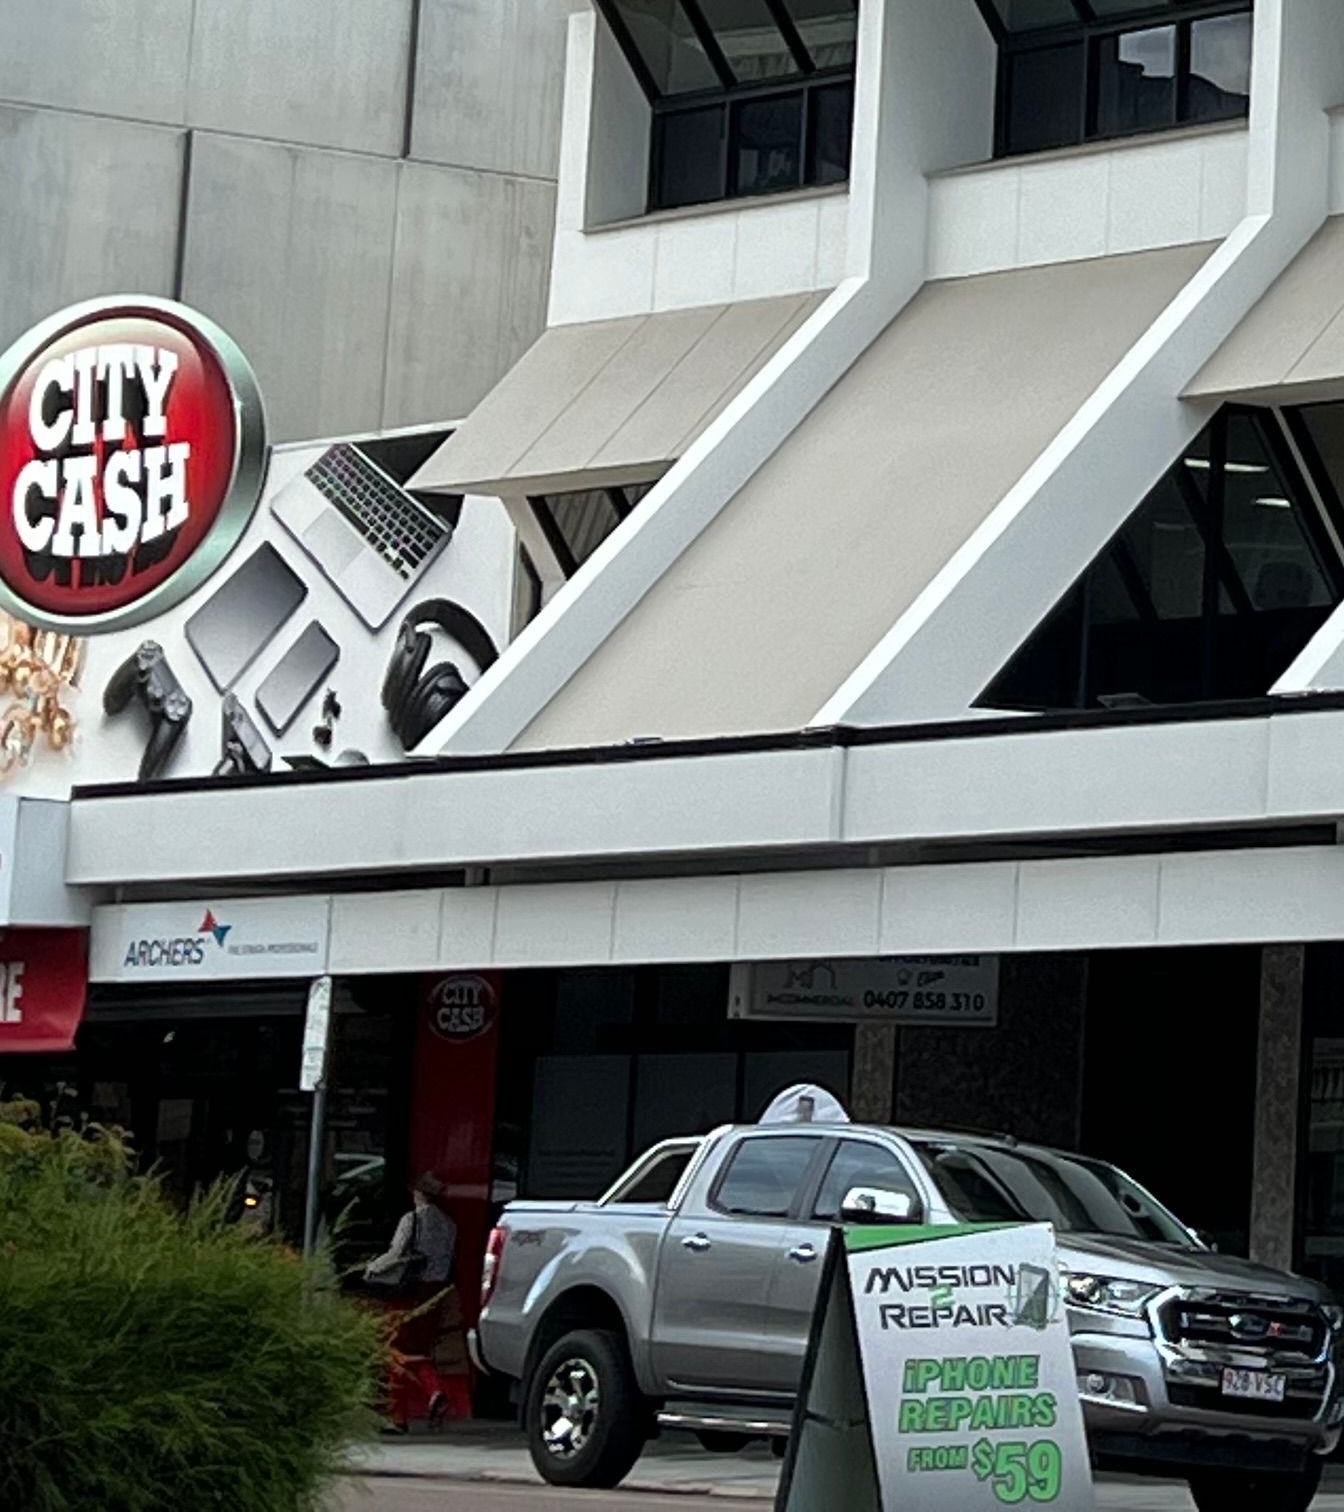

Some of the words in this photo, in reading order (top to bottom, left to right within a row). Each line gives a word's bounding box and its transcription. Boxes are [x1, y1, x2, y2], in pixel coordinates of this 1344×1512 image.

[29, 343, 178, 451] CITY
[13, 442, 191, 557] CASH
[124, 939, 204, 967] ARCHERS
[442, 981, 481, 1004] CITY
[863, 990, 909, 1009] 0407
[913, 991, 946, 1010] 858
[950, 992, 984, 1012] 310
[864, 1264, 1015, 1294] MISSION
[879, 1303, 1009, 1330] REPAIR
[898, 1392, 1057, 1434] REPAIRS
[907, 1445, 968, 1473] FROM
[971, 1437, 1062, 1505] $59
